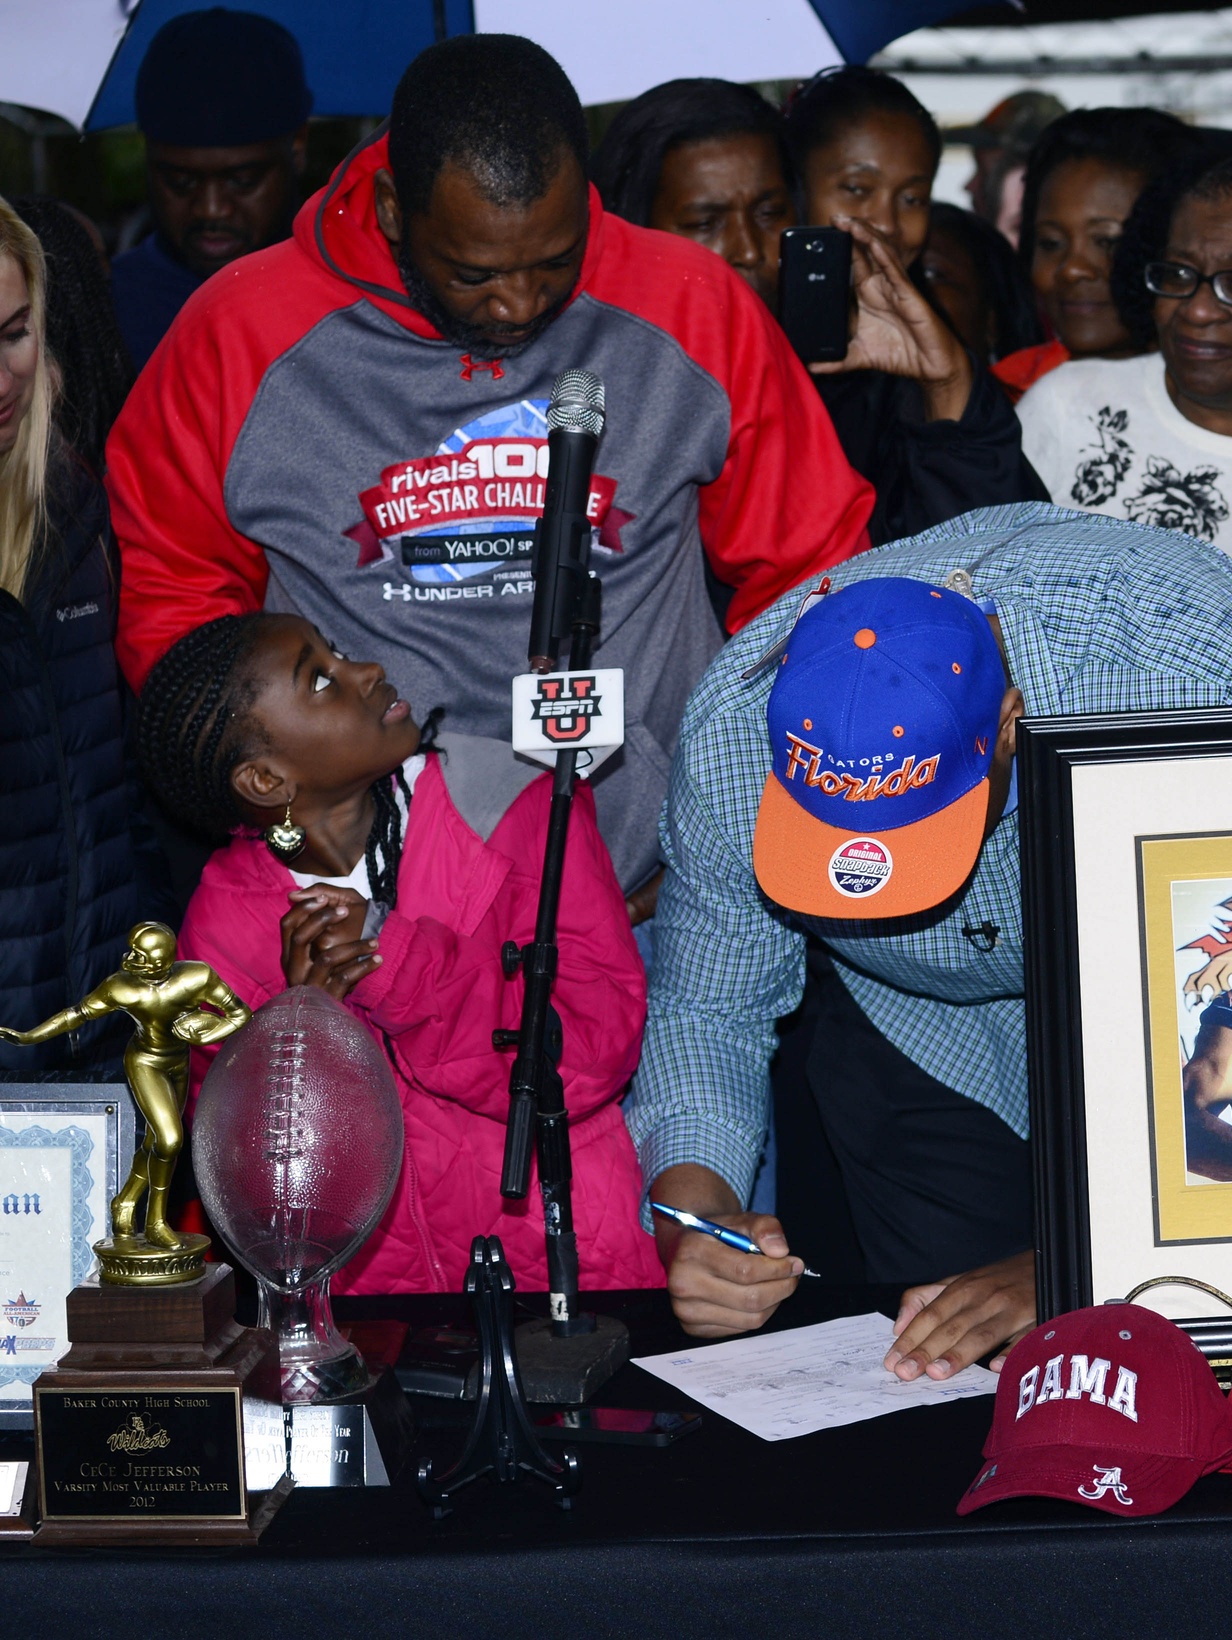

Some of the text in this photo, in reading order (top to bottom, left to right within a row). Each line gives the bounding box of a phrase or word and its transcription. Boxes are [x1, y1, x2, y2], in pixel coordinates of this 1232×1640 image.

[375, 481, 601, 529] FIVE-STAR CHALLE
[414, 546, 441, 558] from
[445, 537, 514, 559] YAHOO!
[414, 583, 494, 601] UNDER
[539, 699, 594, 716] ESPN
[786, 731, 942, 802] Florida
[828, 752, 895, 768] GATORS
[847, 848, 884, 862] ORIGINAL
[1015, 1353, 1138, 1422] BAMA
[106, 1429, 171, 1452] Wildcats
[129, 1496, 156, 1508] 2012
